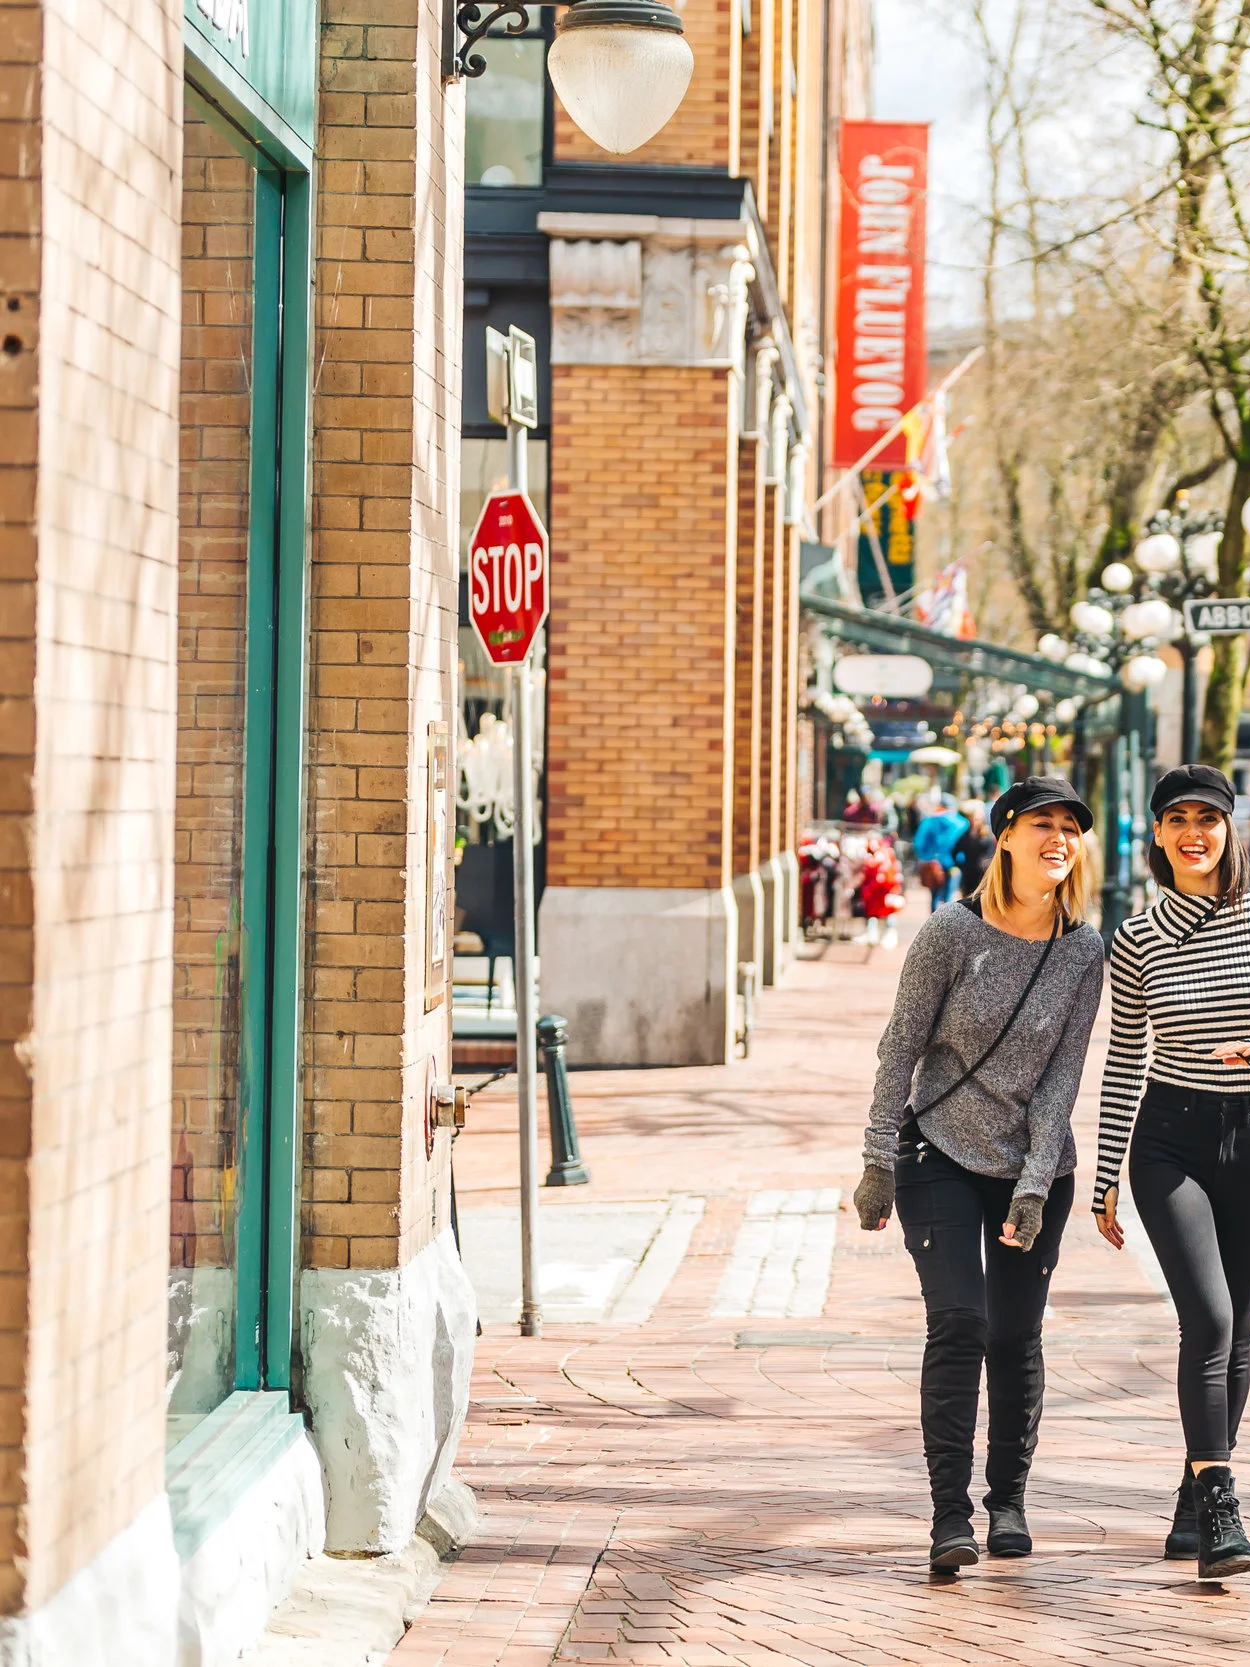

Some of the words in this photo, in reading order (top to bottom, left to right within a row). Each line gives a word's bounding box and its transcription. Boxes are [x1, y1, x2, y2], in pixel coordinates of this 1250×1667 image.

[857, 154, 914, 254] JOHN
[852, 265, 911, 431] FLUEVOG
[472, 543, 543, 615] STOP
